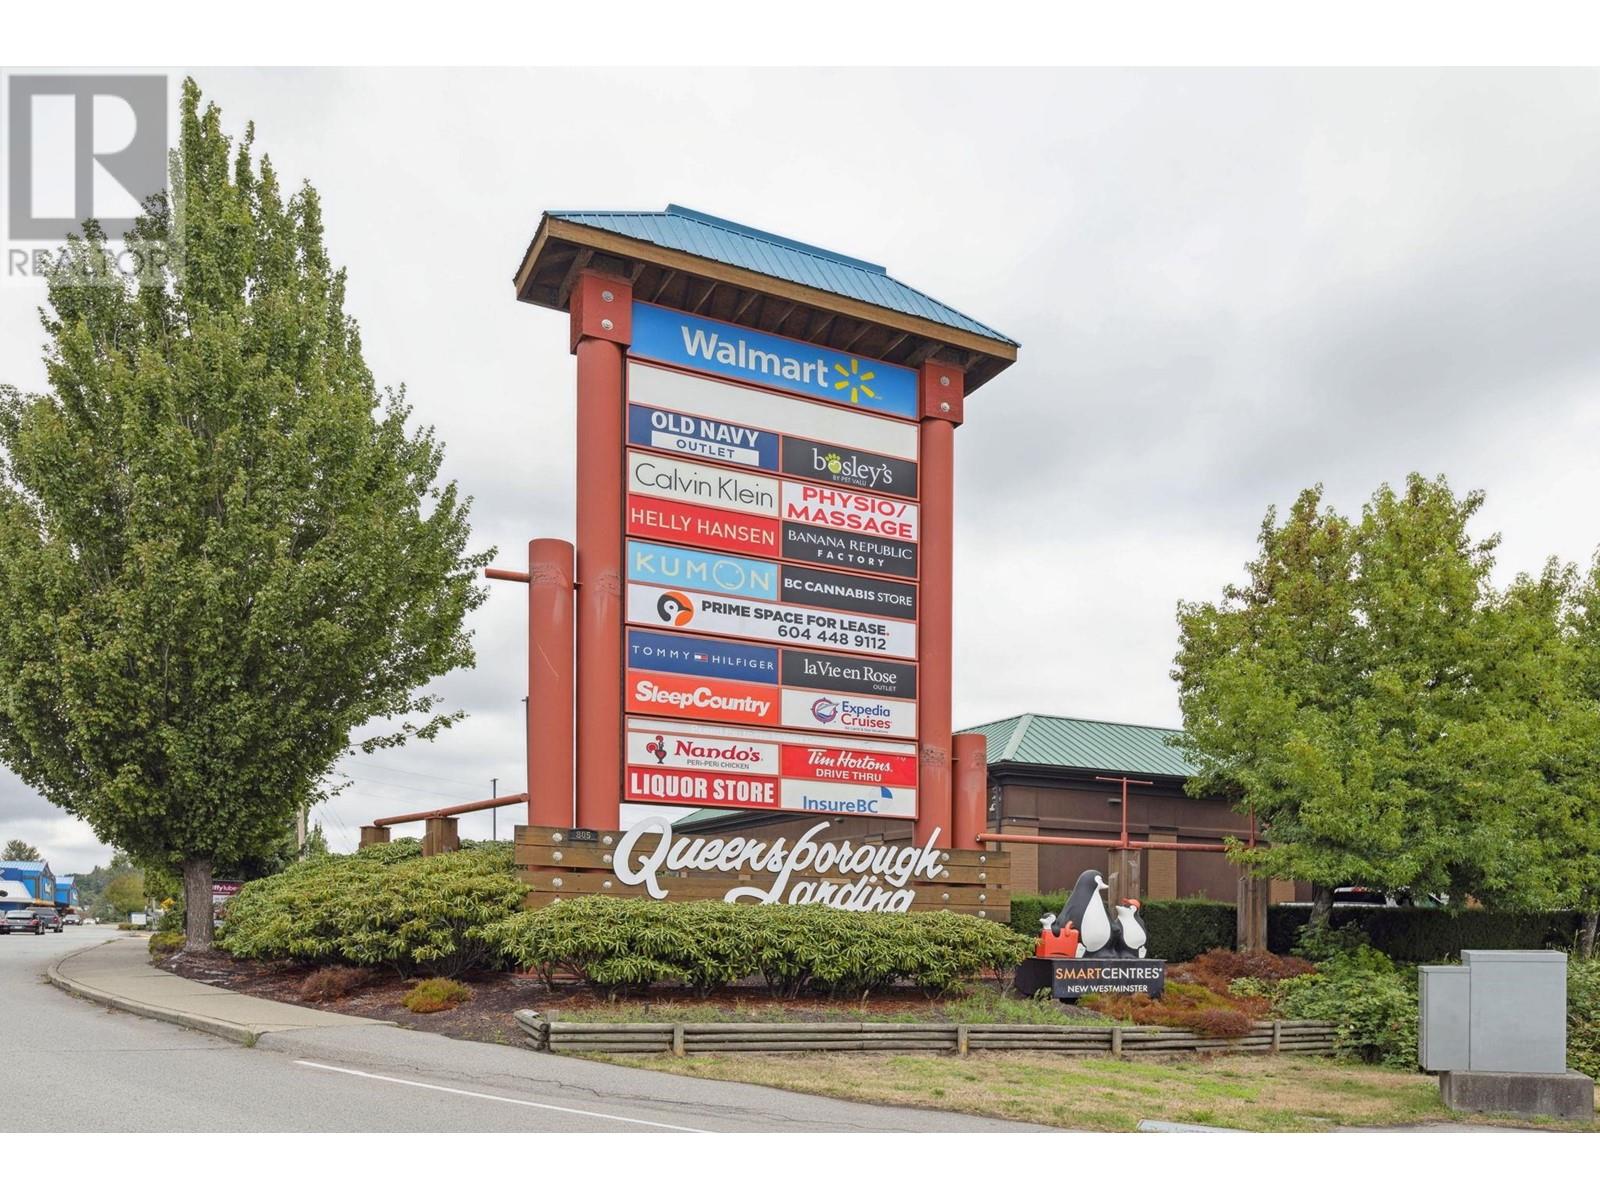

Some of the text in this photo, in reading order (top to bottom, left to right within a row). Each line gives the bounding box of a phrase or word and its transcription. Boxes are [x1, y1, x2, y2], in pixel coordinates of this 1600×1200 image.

[681, 326, 828, 388] Walmart
[651, 411, 760, 447] OLD NAVY
[676, 439, 735, 459] OUTLET
[812, 448, 893, 487] bosley's
[635, 463, 773, 508] Calvin Klein
[802, 486, 907, 518] PHYSIO/
[631, 508, 775, 546] HELLY HANSEN
[787, 503, 913, 539] MASSAGE
[788, 529, 913, 560] BANANA REPUBLIC
[817, 549, 884, 567] FACTORY
[636, 551, 770, 591] KUMON
[784, 578, 913, 607] BC CANNABIS STORE
[702, 600, 751, 617] PRIME
[753, 608, 803, 625] SPACE
[806, 615, 837, 630] FOR
[778, 625, 887, 650] 604 448 9112
[631, 644, 775, 671] TOMMY HILFIGER
[843, 668, 861, 680] en
[863, 666, 897, 684] Rose
[872, 684, 897, 692] OUTLET
[635, 680, 771, 717] SleepCountry
[842, 701, 891, 718] Expedia
[841, 713, 891, 729] Cruises
[674, 740, 761, 762] Nando's
[808, 748, 891, 772] Tim Hortons
[720, 761, 750, 770] CHICKEN
[816, 768, 882, 782] DRIVE THRU
[631, 773, 775, 803] LIQUOR STORE
[803, 795, 879, 814] InsureBC
[613, 816, 944, 899] Queensborough
[1056, 967, 1160, 980] SMARTCENTRES
[1067, 984, 1148, 993] NEW WESTMINSTER
